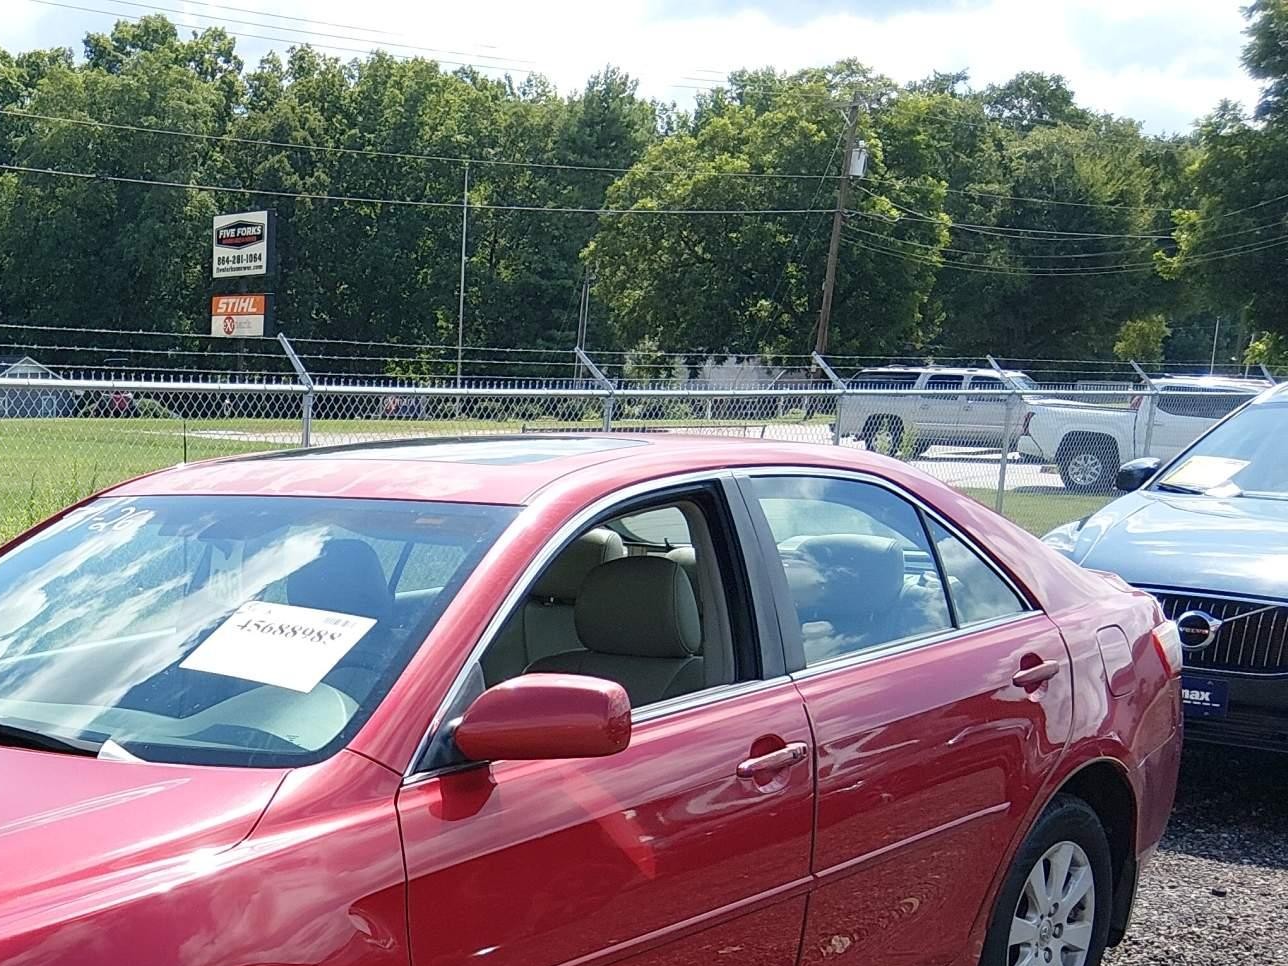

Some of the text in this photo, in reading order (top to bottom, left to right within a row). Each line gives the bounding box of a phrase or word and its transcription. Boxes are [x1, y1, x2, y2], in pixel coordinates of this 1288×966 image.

[218, 228, 237, 240] FIVE
[236, 225, 262, 237] FORKS
[217, 252, 262, 266] 864-281-1064
[216, 297, 257, 313] STIHL
[236, 617, 344, 645] 45688988
